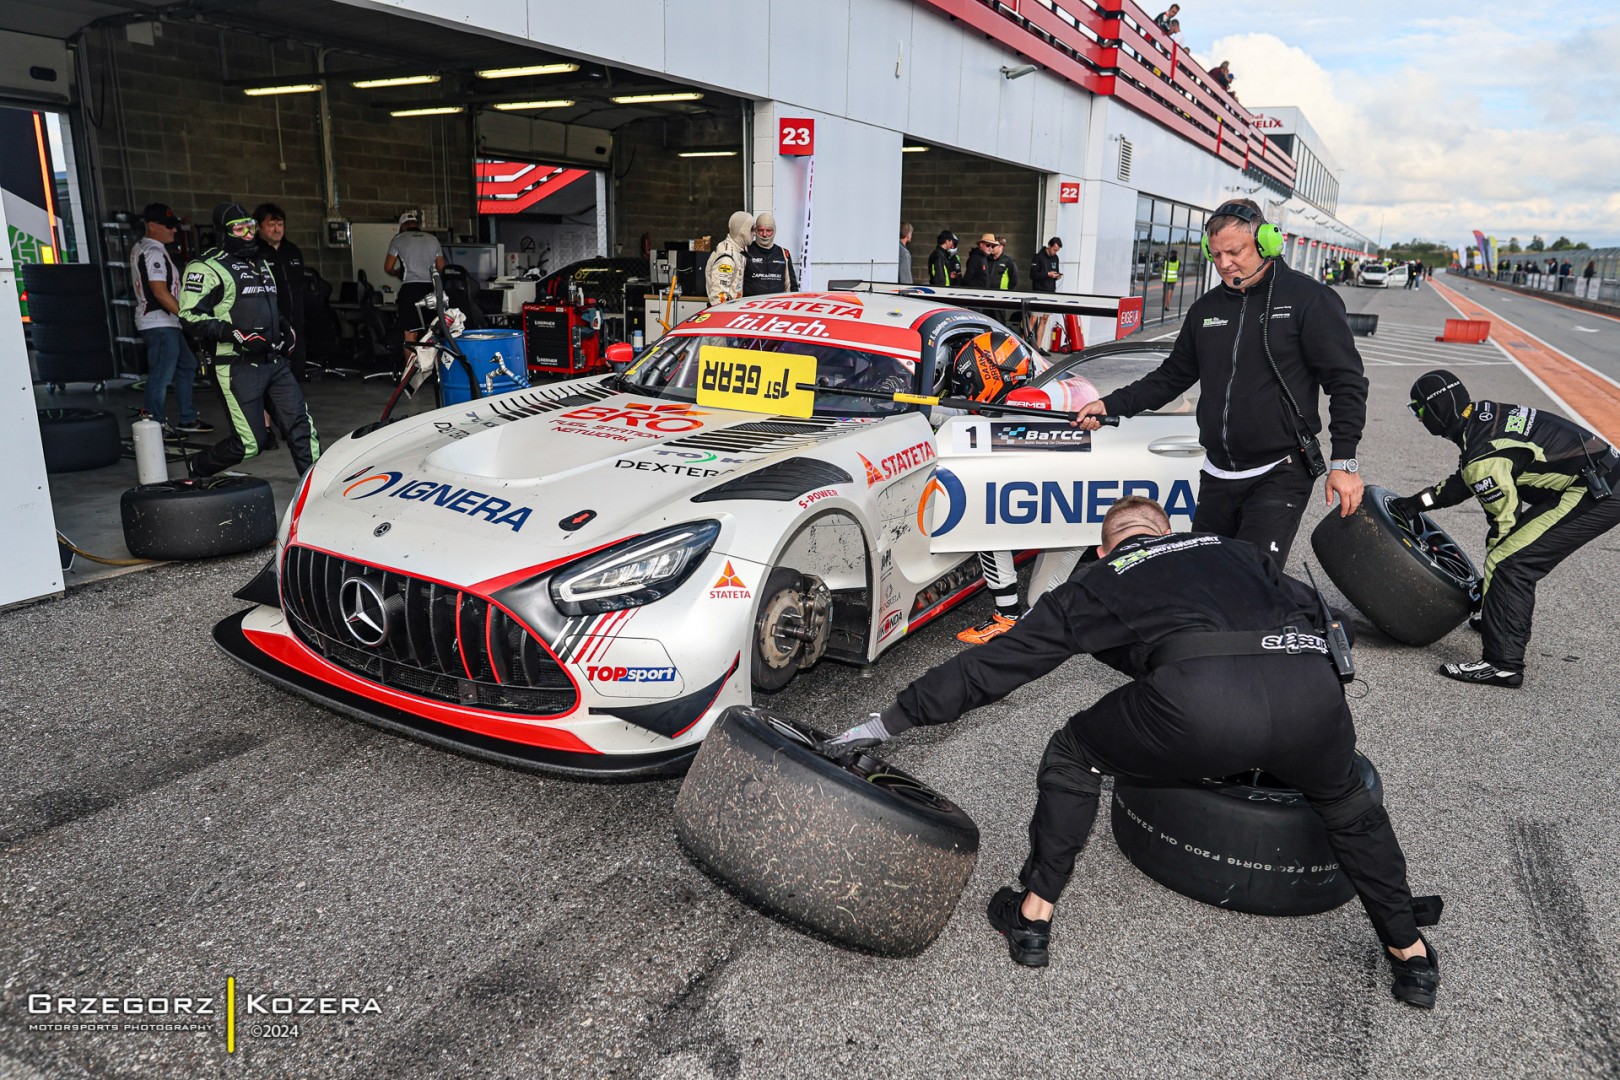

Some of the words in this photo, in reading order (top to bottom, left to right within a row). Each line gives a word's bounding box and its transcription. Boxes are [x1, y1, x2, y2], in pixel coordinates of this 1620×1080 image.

[782, 127, 811, 146] 23
[1061, 187, 1078, 198] 22
[739, 300, 864, 320] STATETA
[725, 313, 830, 338] fri.tech.
[702, 360, 762, 396] GEAR
[764, 368, 790, 400] 1ST
[1447, 380, 1461, 390] GEAR
[549, 419, 587, 428] FUEL
[592, 424, 665, 440] STATION
[559, 406, 704, 433] BRO
[551, 426, 634, 443] NETWORK
[965, 426, 978, 449] 1
[1026, 430, 1084, 441] BaTCC
[881, 440, 936, 480] STATETA
[388, 479, 533, 533] IGNERA
[798, 488, 839, 510] S-POWER
[709, 590, 751, 600] STATETA
[587, 665, 674, 683] TOPsport
[1185, 843, 1221, 862] F200
